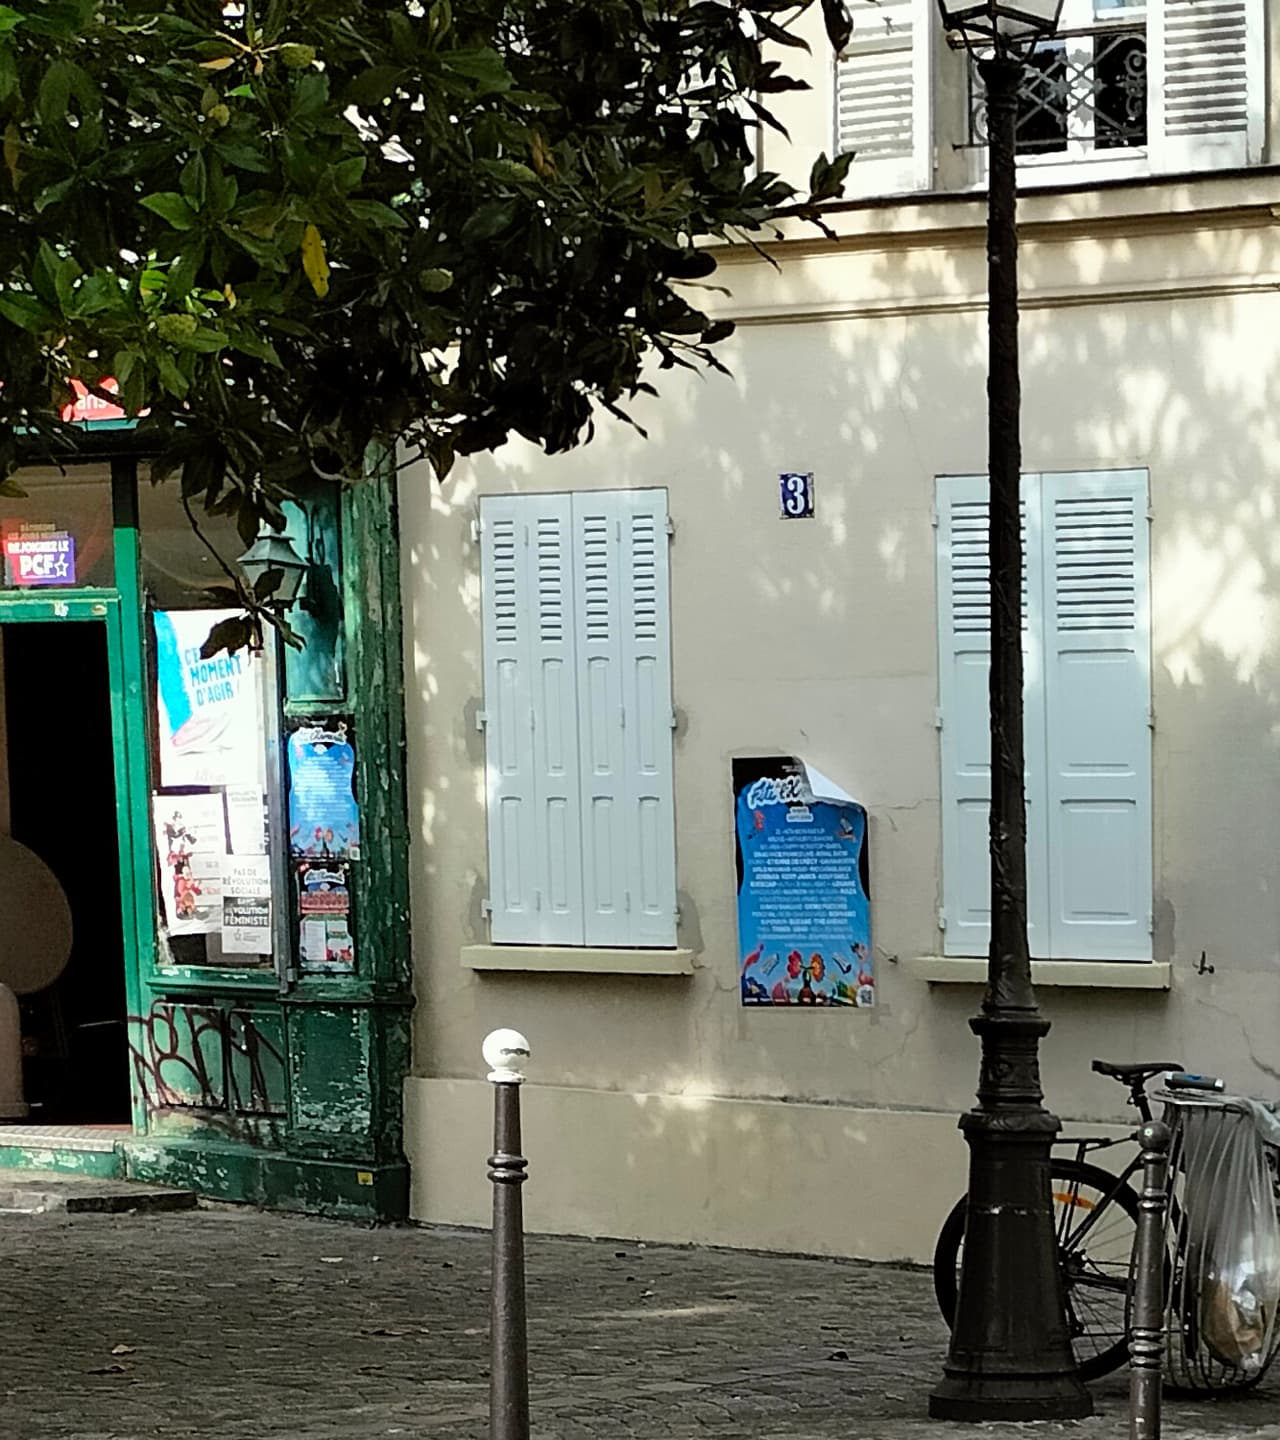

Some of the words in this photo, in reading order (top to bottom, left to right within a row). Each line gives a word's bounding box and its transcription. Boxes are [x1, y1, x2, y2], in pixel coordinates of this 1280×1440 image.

[787, 477, 805, 514] 3
[20, 554, 55, 576] PCF
[190, 655, 241, 687] MOMENT
[197, 682, 233, 706] D'AGIR
[225, 913, 269, 926] FÉMINISTE
